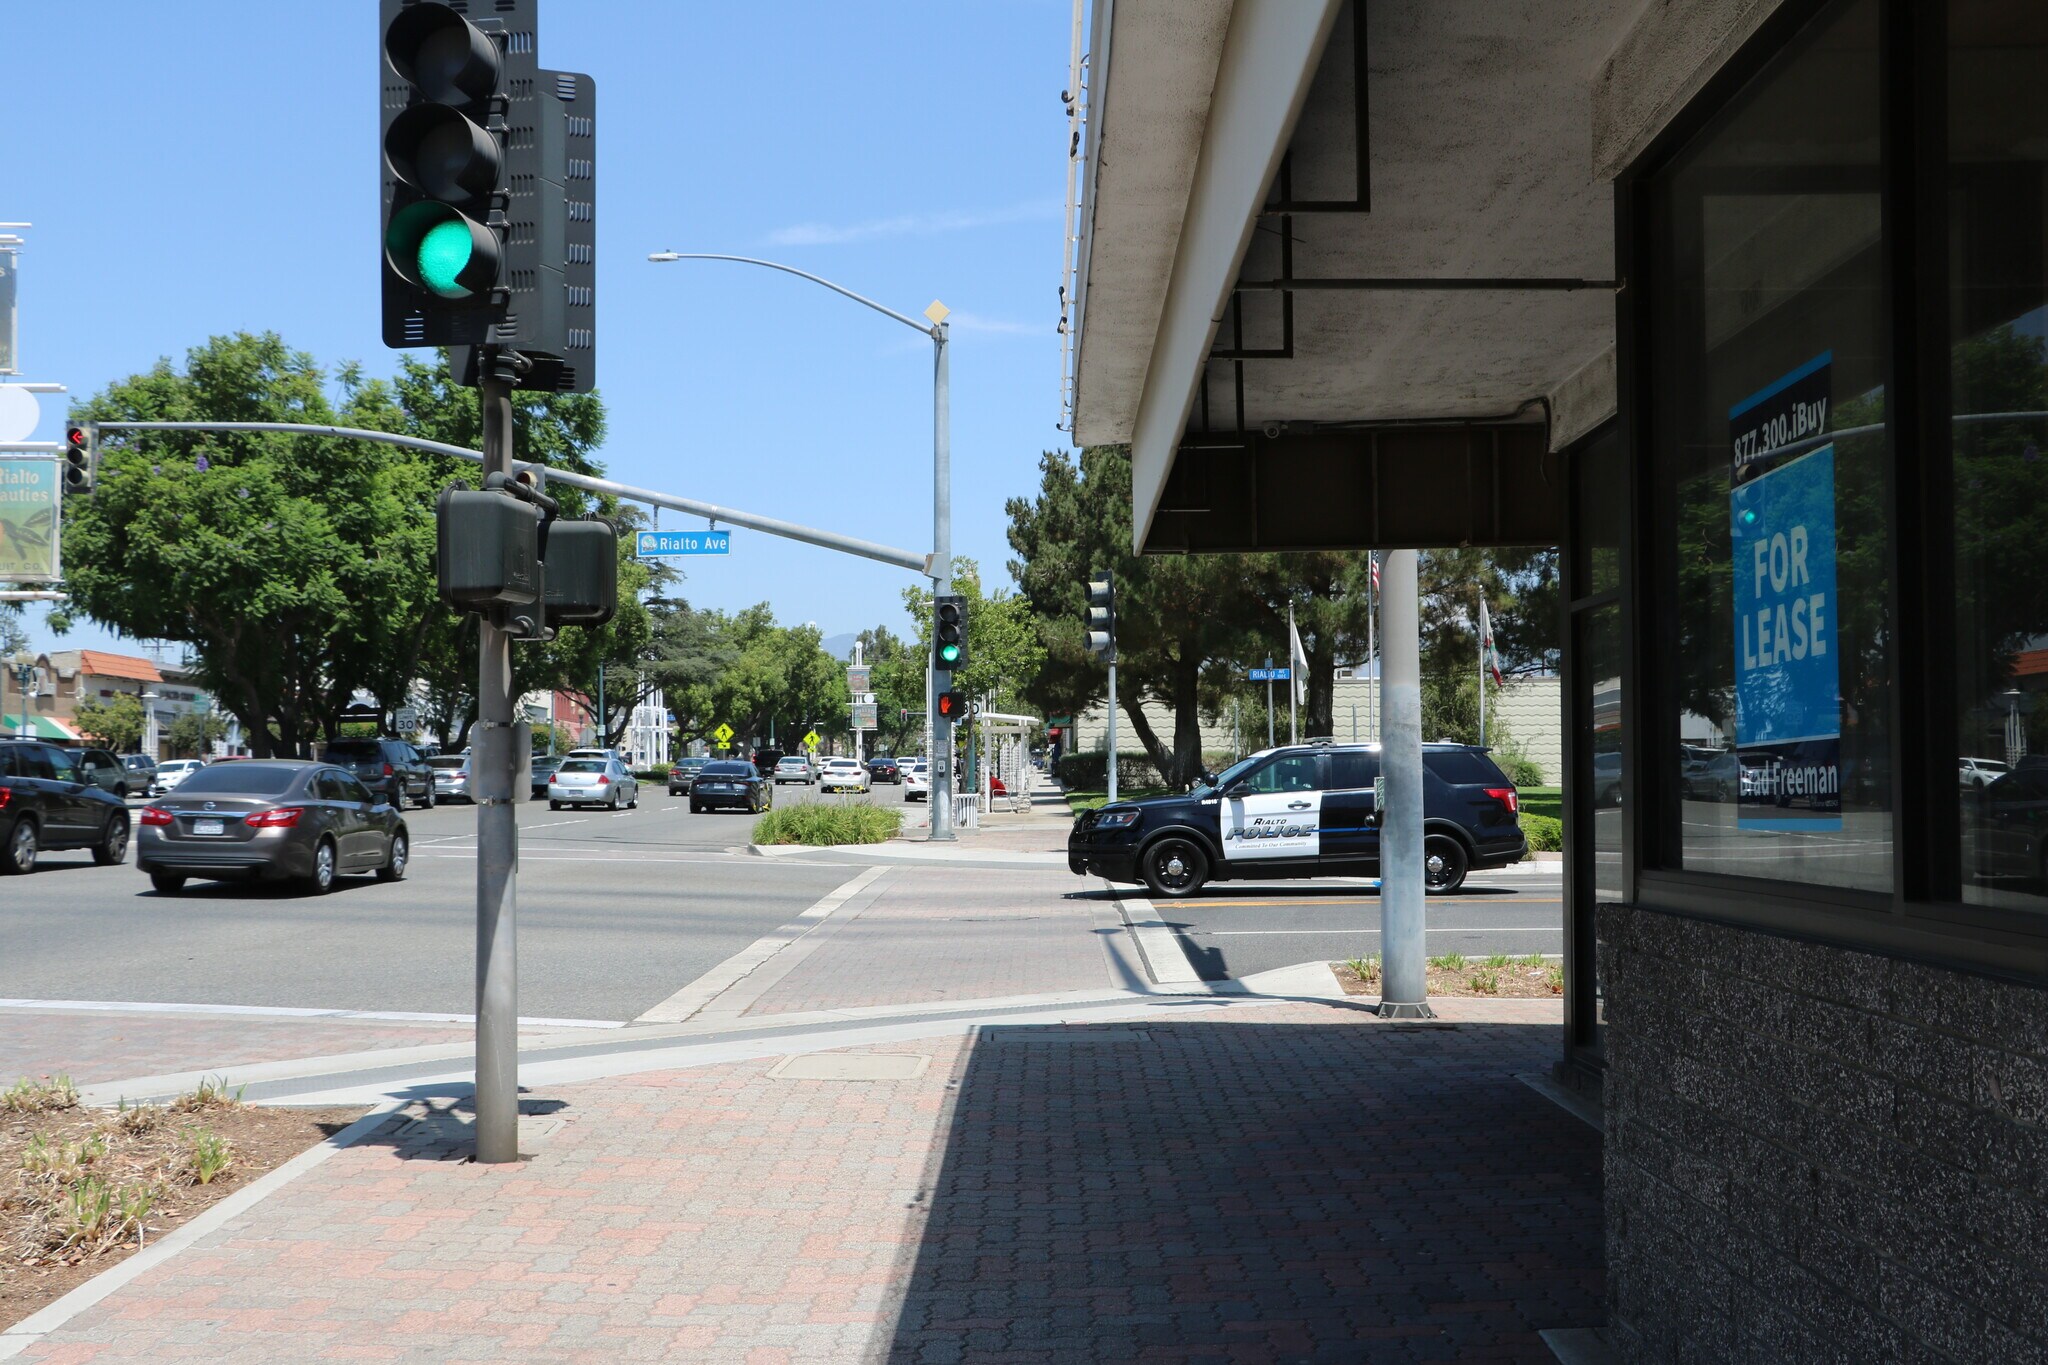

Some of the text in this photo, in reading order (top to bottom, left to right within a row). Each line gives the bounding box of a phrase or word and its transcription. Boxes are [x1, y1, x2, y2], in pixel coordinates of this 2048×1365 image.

[1734, 397, 1827, 468] 877.300.iBuy
[660, 537, 727, 550] Rialto Ave
[1754, 525, 1810, 598] FOR
[1743, 592, 1827, 671] LEASE
[1252, 670, 1276, 679] RIALTO
[398, 720, 413, 729] 30
[1740, 760, 1838, 796] Brad Freeman
[1254, 818, 1287, 826] RIALTO
[1225, 824, 1315, 840] POLICE
